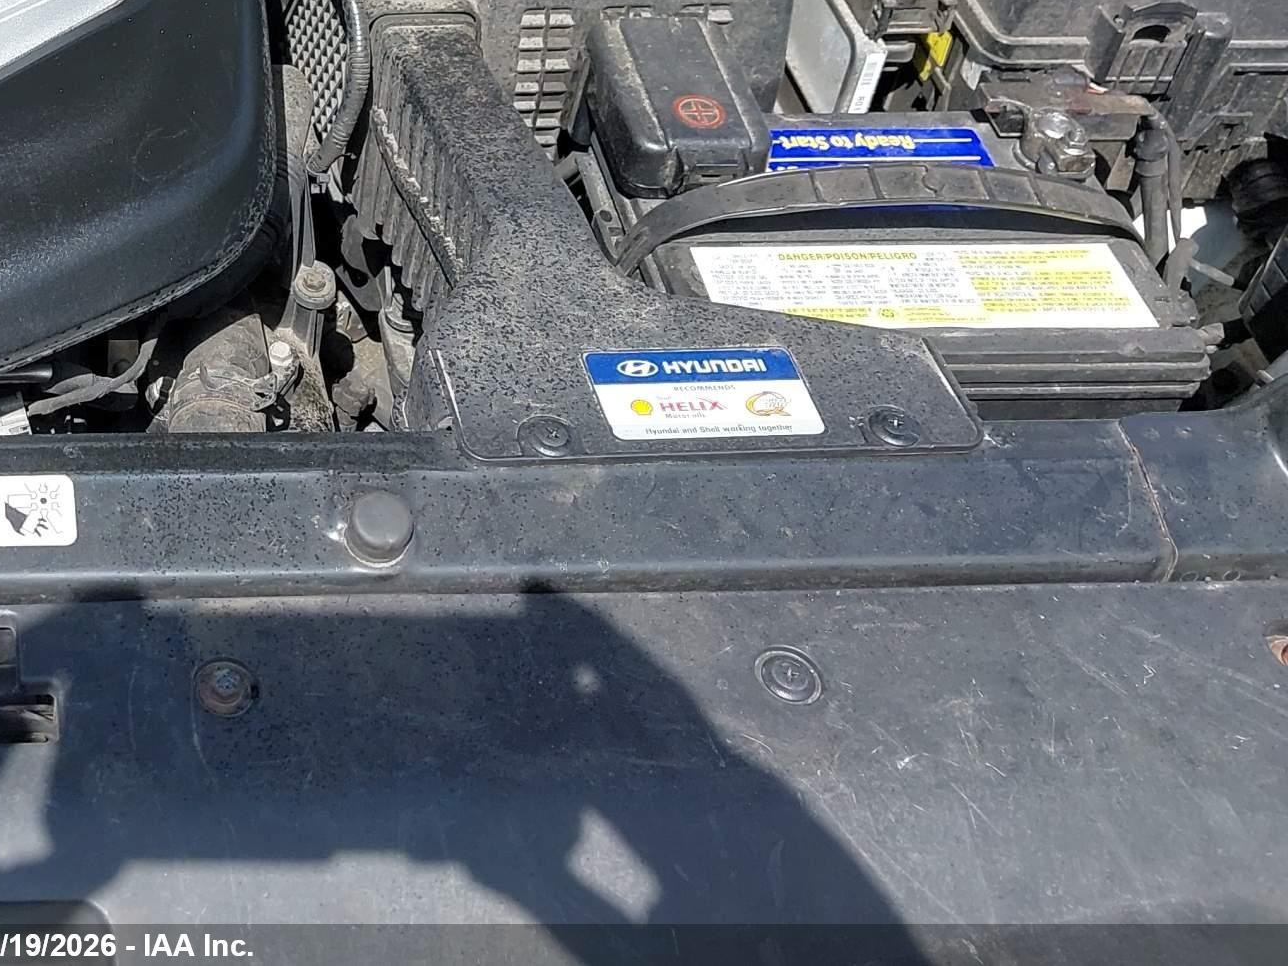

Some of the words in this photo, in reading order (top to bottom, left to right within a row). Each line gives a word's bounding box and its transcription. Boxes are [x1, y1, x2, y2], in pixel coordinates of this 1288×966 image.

[779, 135, 829, 151] Start
[831, 135, 854, 150] to
[855, 133, 916, 151] Ready
[662, 359, 768, 375] HYUNDAI
[659, 401, 725, 413] HELIX
[645, 427, 680, 436] Hyundai
[682, 426, 698, 434] and
[700, 425, 721, 434] Shell
[723, 425, 756, 434] working
[758, 424, 793, 433] together
